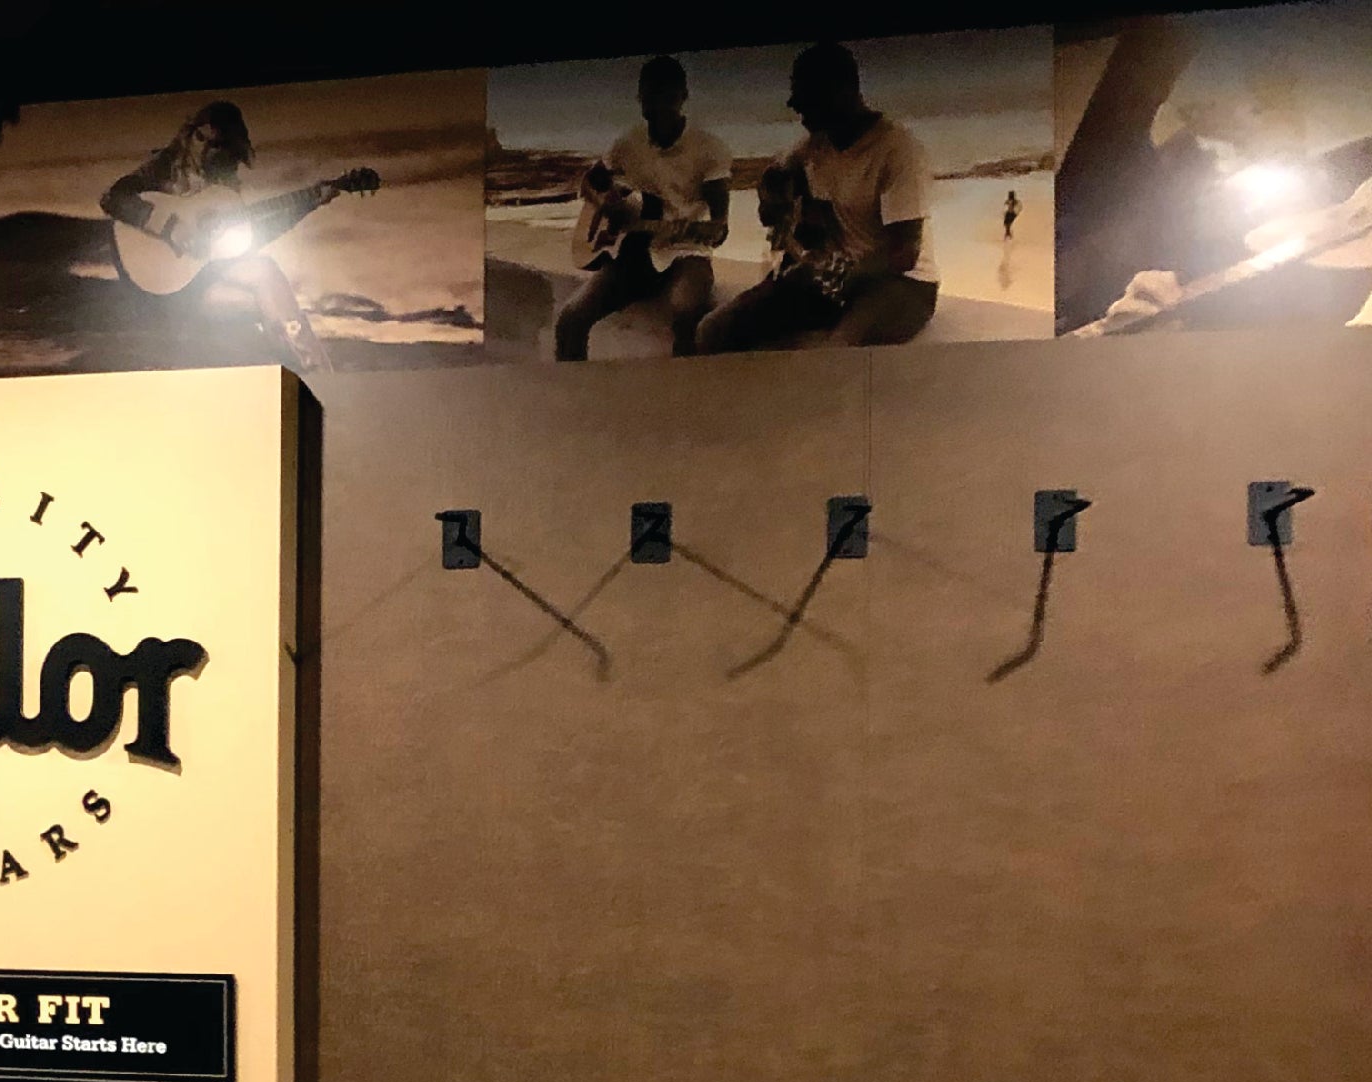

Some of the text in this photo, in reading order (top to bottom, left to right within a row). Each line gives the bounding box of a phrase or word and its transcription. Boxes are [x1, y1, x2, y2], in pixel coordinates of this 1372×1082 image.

[37, 995, 110, 1024] FIT
[0, 1034, 58, 1050] Guitar
[61, 1035, 116, 1052] Starts
[120, 1037, 167, 1054] Here
